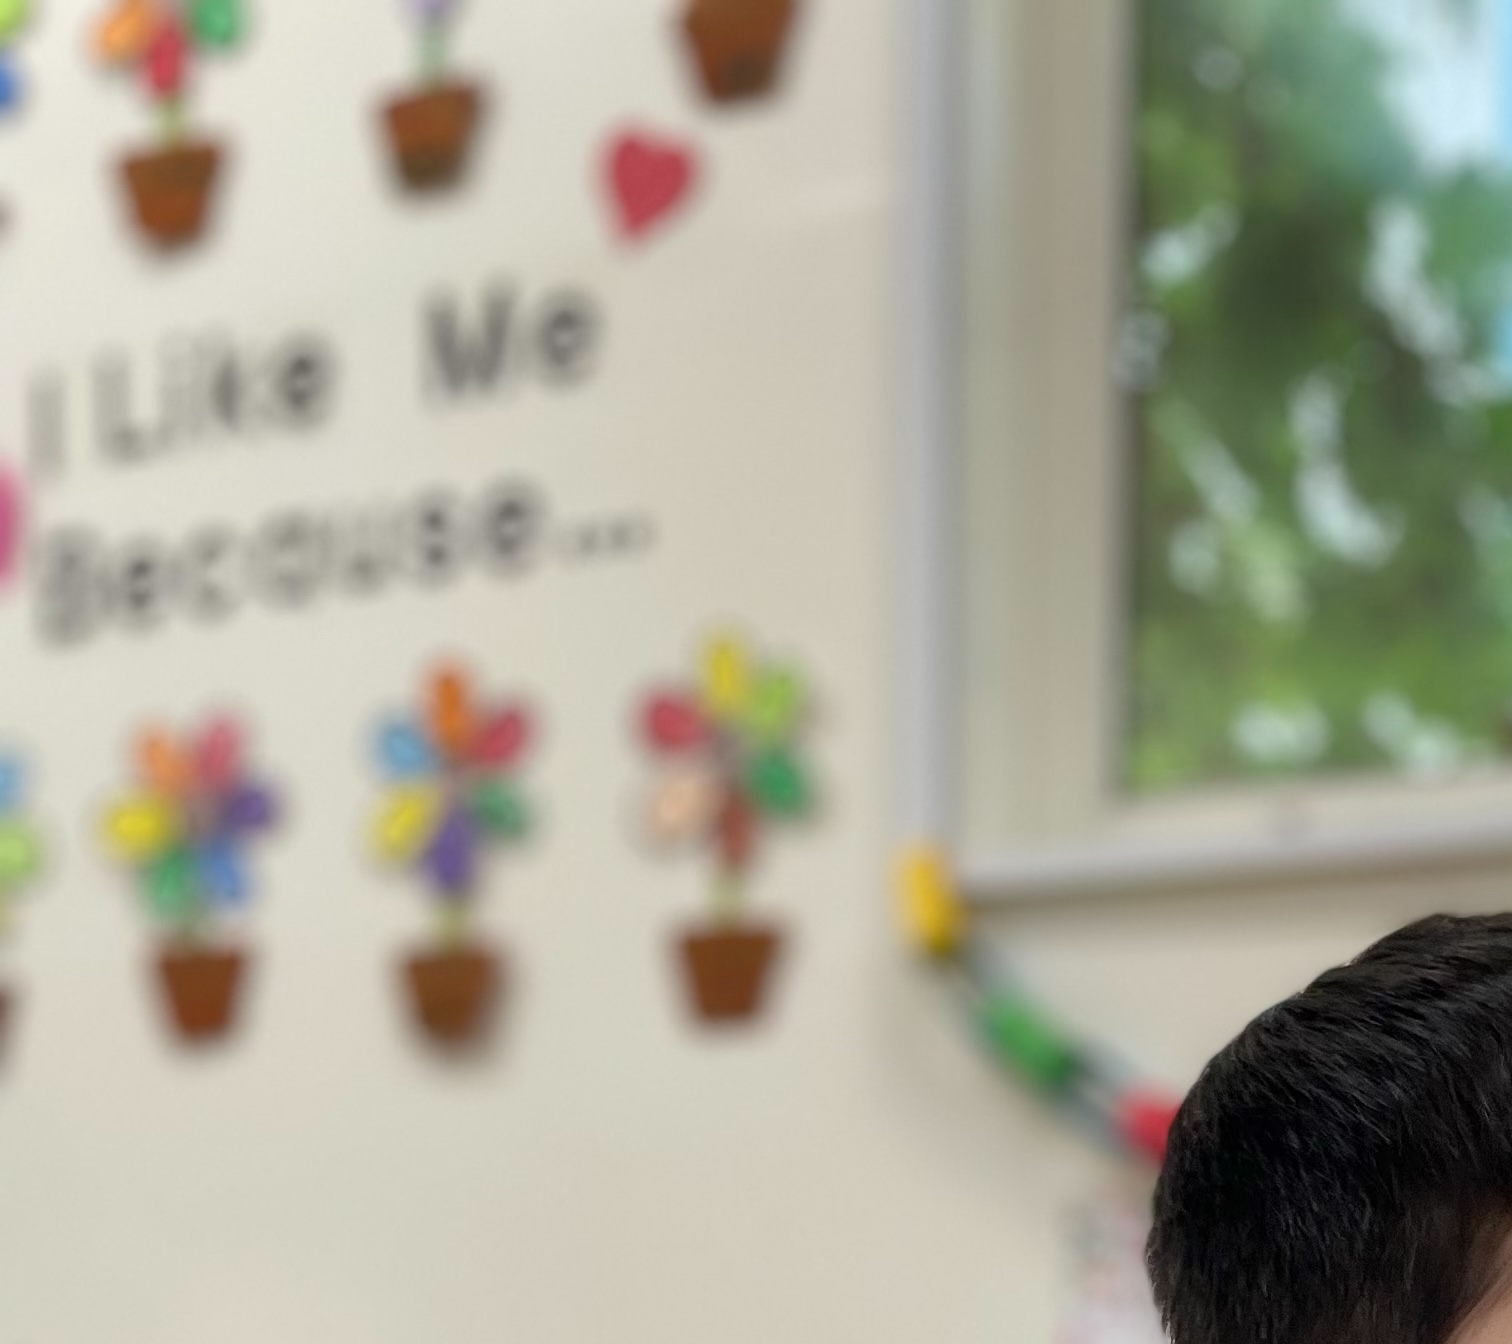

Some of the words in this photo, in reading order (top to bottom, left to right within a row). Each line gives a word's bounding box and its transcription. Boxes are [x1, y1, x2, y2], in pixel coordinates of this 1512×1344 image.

[30, 368, 64, 476] I
[96, 330, 334, 462] Like
[424, 280, 598, 408] Me
